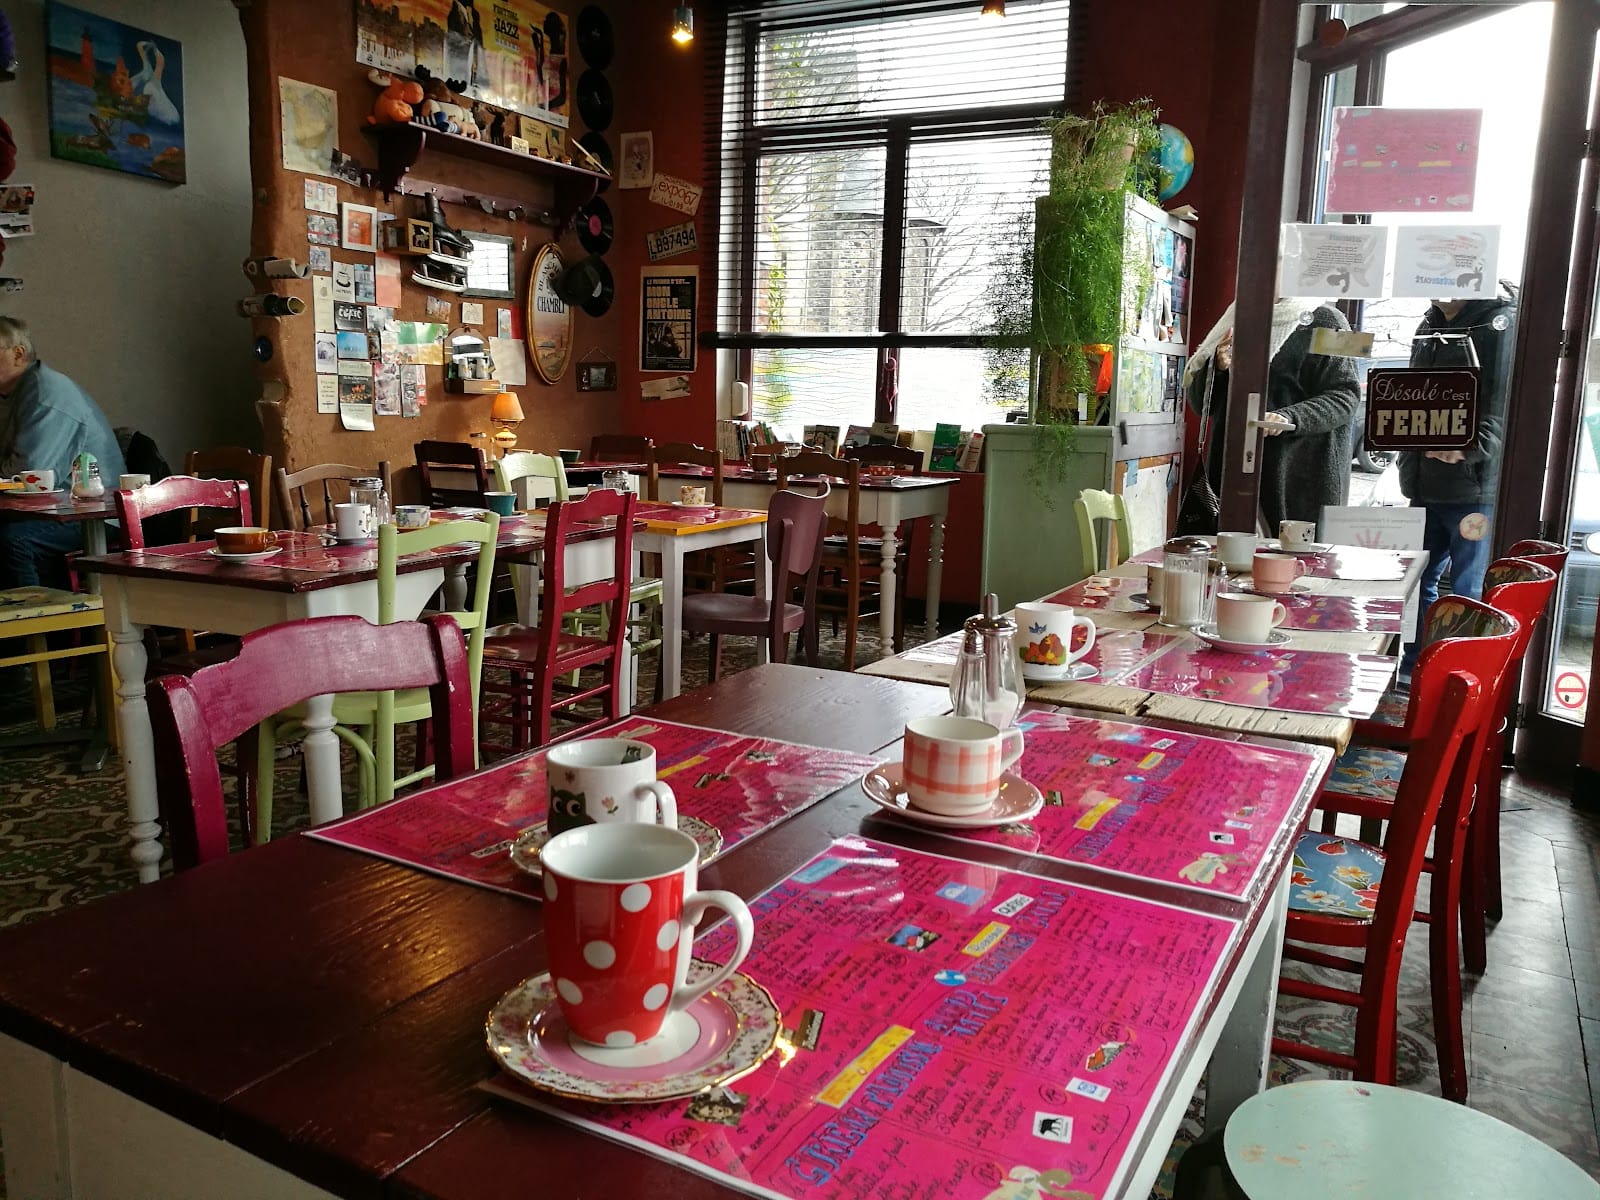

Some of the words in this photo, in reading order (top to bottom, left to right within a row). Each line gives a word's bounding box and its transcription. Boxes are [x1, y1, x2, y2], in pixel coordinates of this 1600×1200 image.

[494, 17, 520, 39] JAZZ
[659, 181, 698, 206] expo67
[649, 229, 696, 255] LB97494
[646, 286, 671, 297] MON
[646, 297, 679, 308] ONCLE
[646, 309, 692, 320] ANTOINE
[1375, 378, 1440, 401] Désolé
[1376, 403, 1468, 436] FERMÉ
